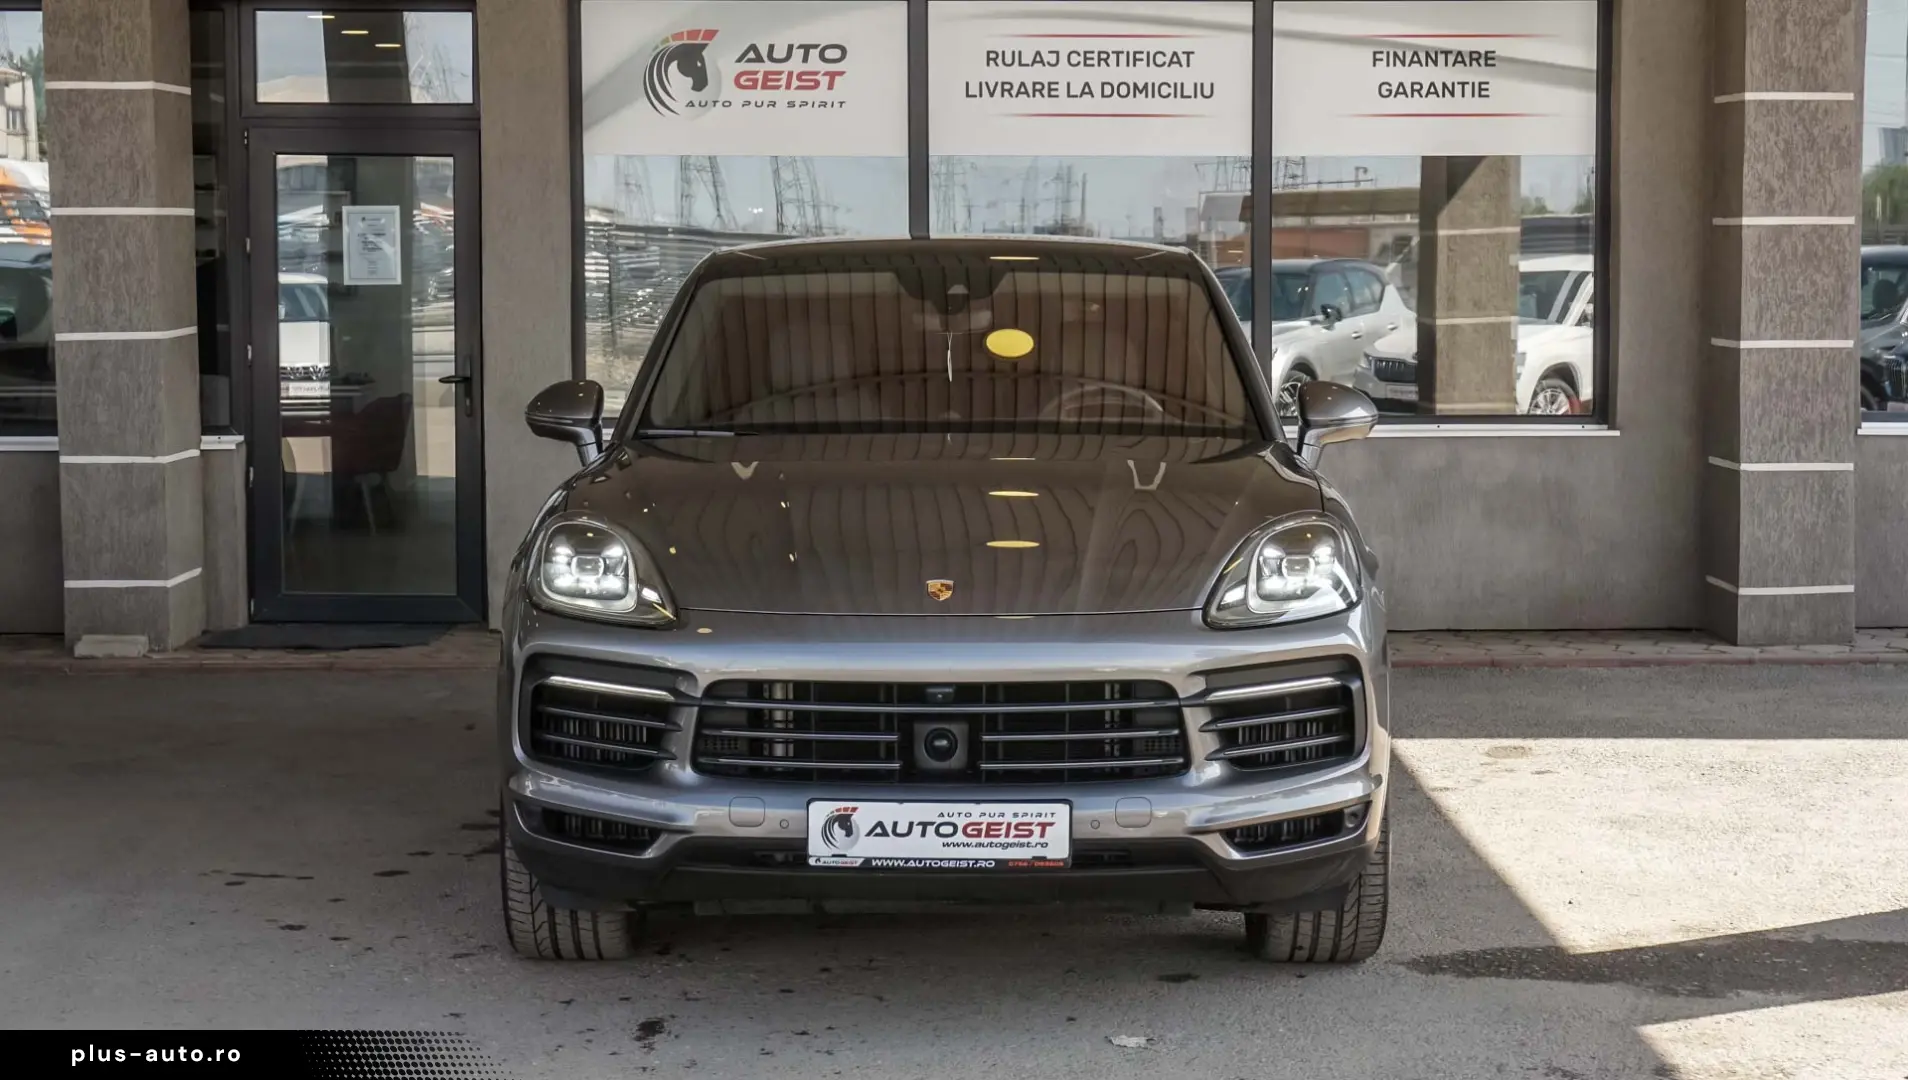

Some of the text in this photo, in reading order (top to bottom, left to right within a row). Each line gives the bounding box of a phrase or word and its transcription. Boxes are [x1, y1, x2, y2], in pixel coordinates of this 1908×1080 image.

[735, 43, 848, 64] AUTO
[986, 50, 1196, 68] RULAJ CERTIFICAT
[1372, 49, 1497, 68] FINANTARE
[734, 70, 847, 91] GEIST
[1377, 80, 1491, 99] GARANTIE
[965, 81, 1215, 99] LIVRARE LA DOMICILIU
[684, 100, 847, 109] AUTO PUR SPIRIT
[937, 811, 1057, 819] AUTO PUR SPIRIT
[942, 840, 1049, 850] www.autogeist.ro
[871, 859, 996, 868] WWW.AUTOGEIST.RO
